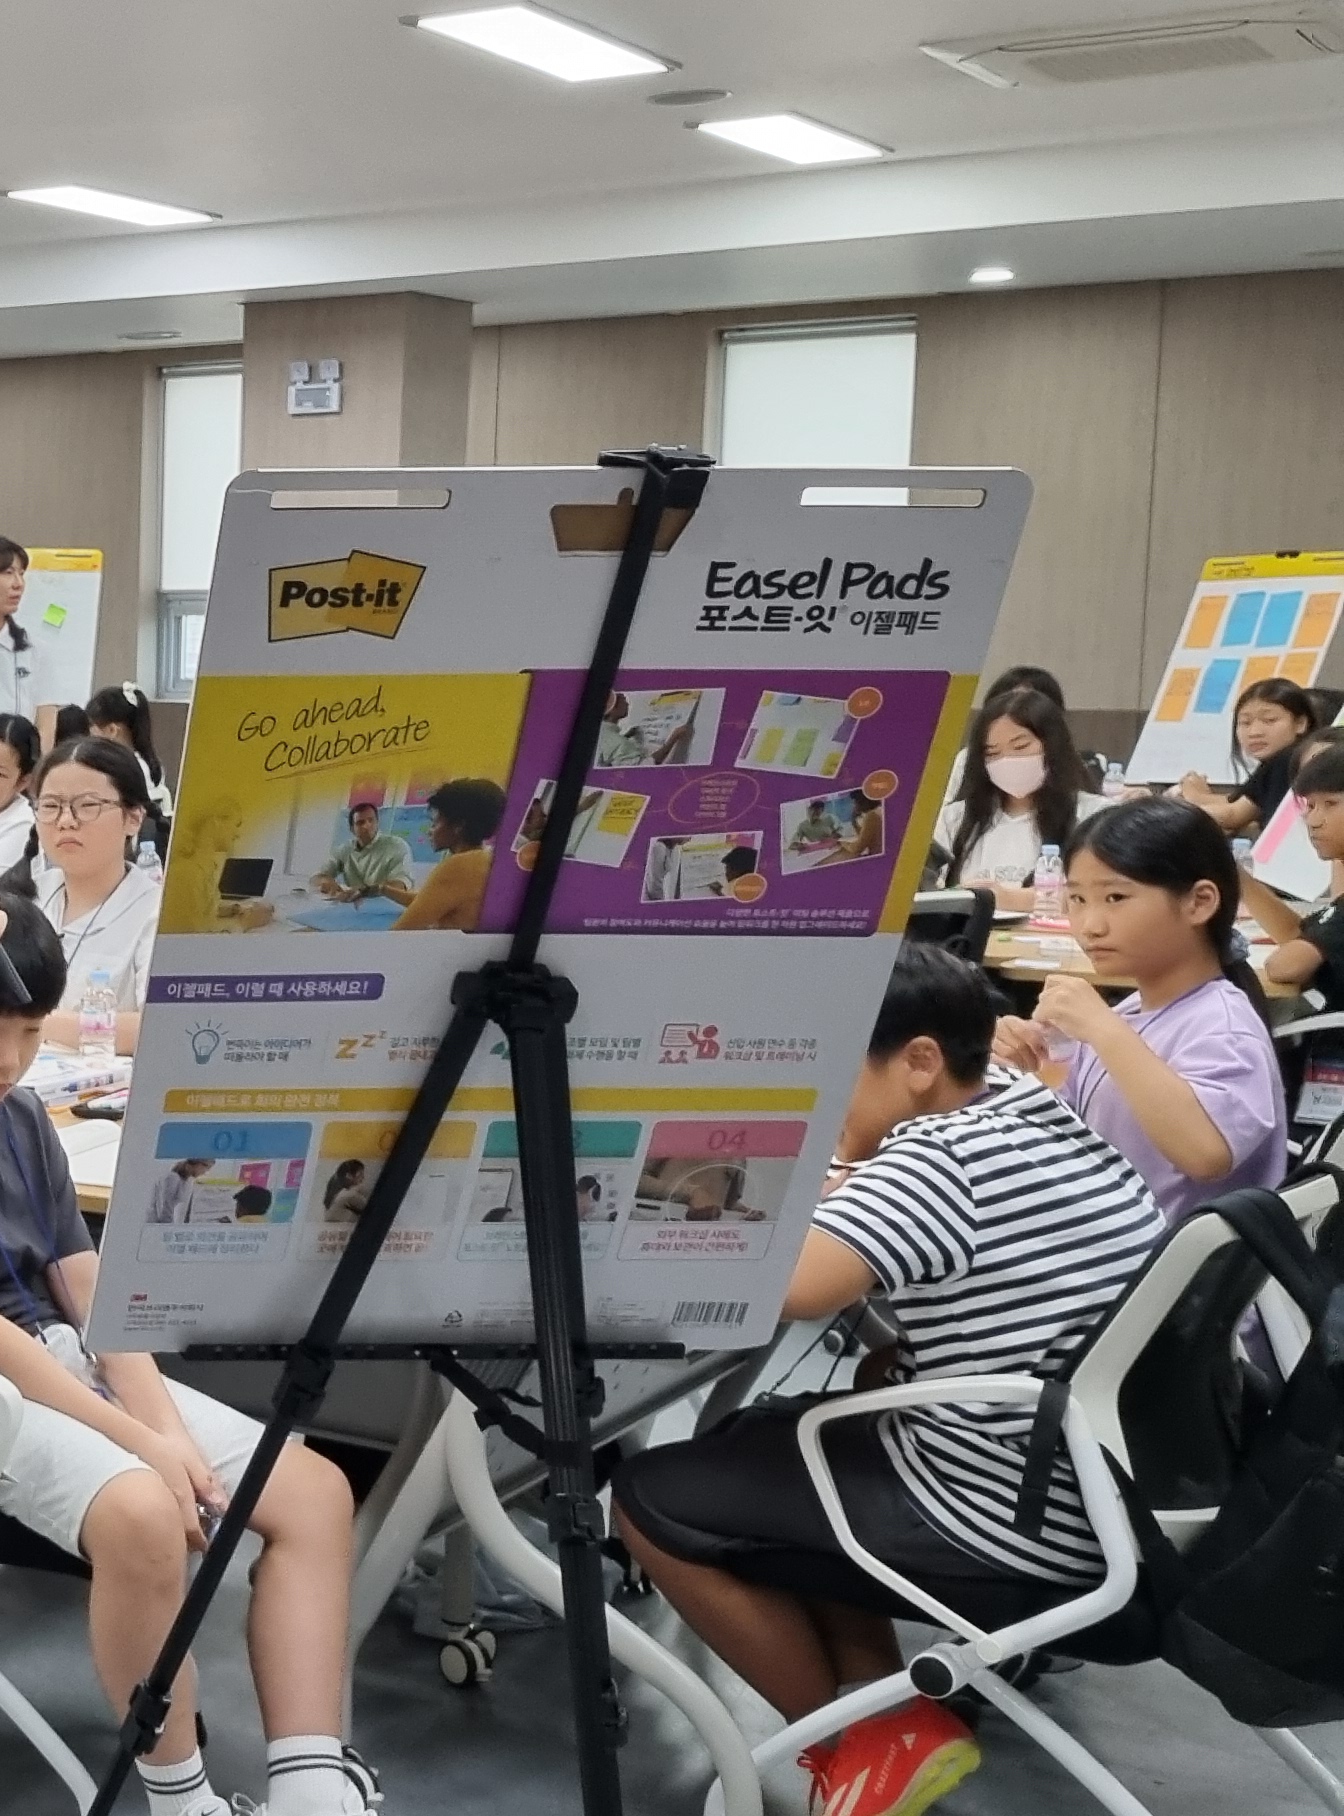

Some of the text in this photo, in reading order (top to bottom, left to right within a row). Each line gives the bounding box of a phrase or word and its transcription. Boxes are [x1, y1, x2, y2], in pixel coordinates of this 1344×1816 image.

[279, 579, 402, 608] Post-it
[705, 557, 950, 601] Easel Pads
[850, 610, 942, 636] 이젤패드
[237, 711, 277, 742] Go
[264, 715, 430, 772] Collaborate
[268, 982, 284, 997] 때
[286, 980, 369, 997] 사용하세요!
[708, 1130, 747, 1151] 04
